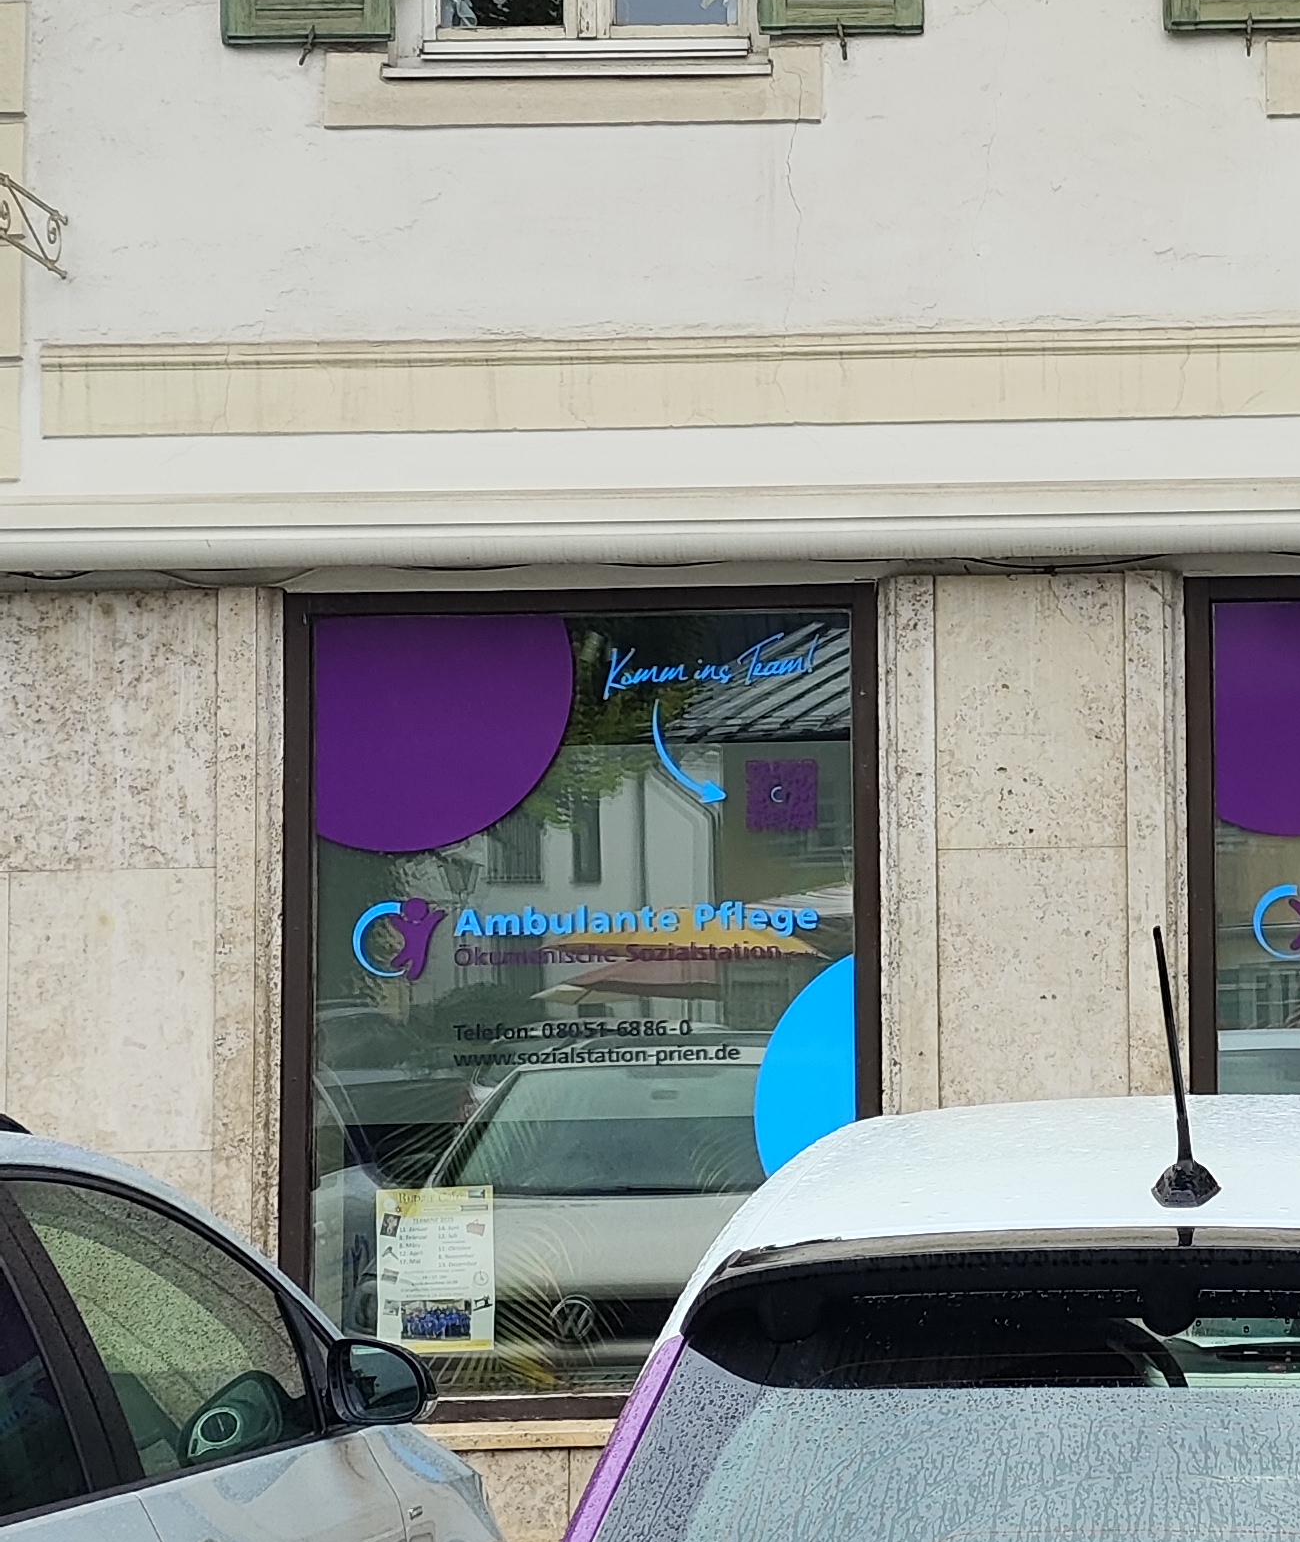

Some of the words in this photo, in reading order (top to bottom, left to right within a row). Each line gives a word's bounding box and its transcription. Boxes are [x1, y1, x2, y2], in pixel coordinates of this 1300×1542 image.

[602, 647, 688, 701] Komm
[694, 658, 734, 685] ins
[736, 631, 820, 686] Team!
[453, 904, 681, 938] Ambulante
[693, 900, 821, 938] Pflege
[453, 1023, 534, 1042] Telefon:
[541, 1018, 692, 1039] 08051-6886-0
[453, 1043, 742, 1067] www.sozialstation-prien.de
